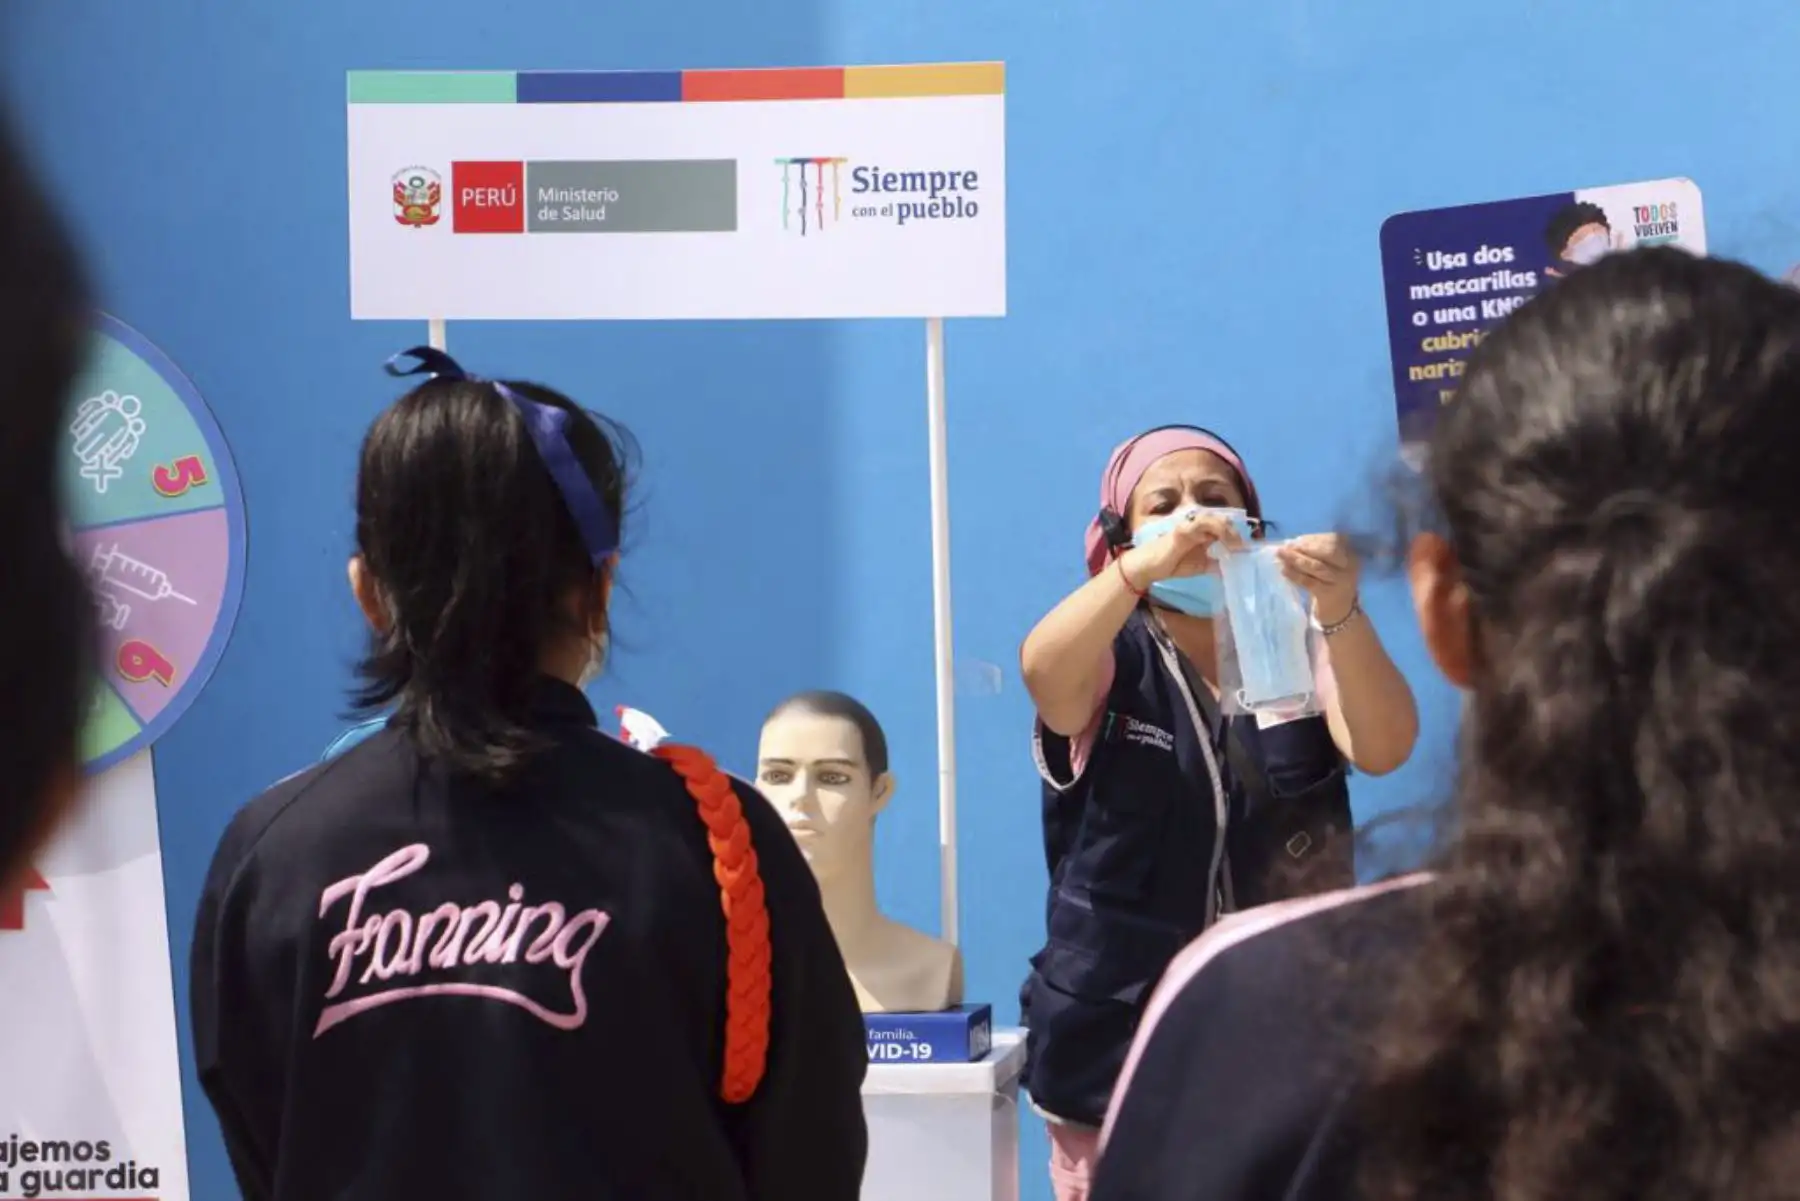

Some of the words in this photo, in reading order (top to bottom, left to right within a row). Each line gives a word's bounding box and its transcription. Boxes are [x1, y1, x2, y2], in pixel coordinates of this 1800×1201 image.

[852, 165, 978, 198] Siempre
[461, 184, 516, 207] PERÚ
[537, 186, 619, 203] Ministerio
[537, 206, 559, 221] de
[563, 206, 606, 221] Salud
[852, 207, 877, 217] con
[881, 203, 893, 216] el
[897, 196, 978, 225] pueblo
[1632, 201, 1678, 224] TODOS
[1633, 220, 1678, 237] VUELVEN
[1426, 250, 1468, 271] Usa
[1473, 244, 1515, 265] dos
[1409, 270, 1538, 300] mascarillas
[1412, 311, 1429, 327] o
[1433, 305, 1477, 324] una
[1421, 328, 1490, 352] cubri
[152, 455, 207, 496] 5
[313, 843, 611, 1040] Fanning
[20, 1160, 159, 1198] guardia
